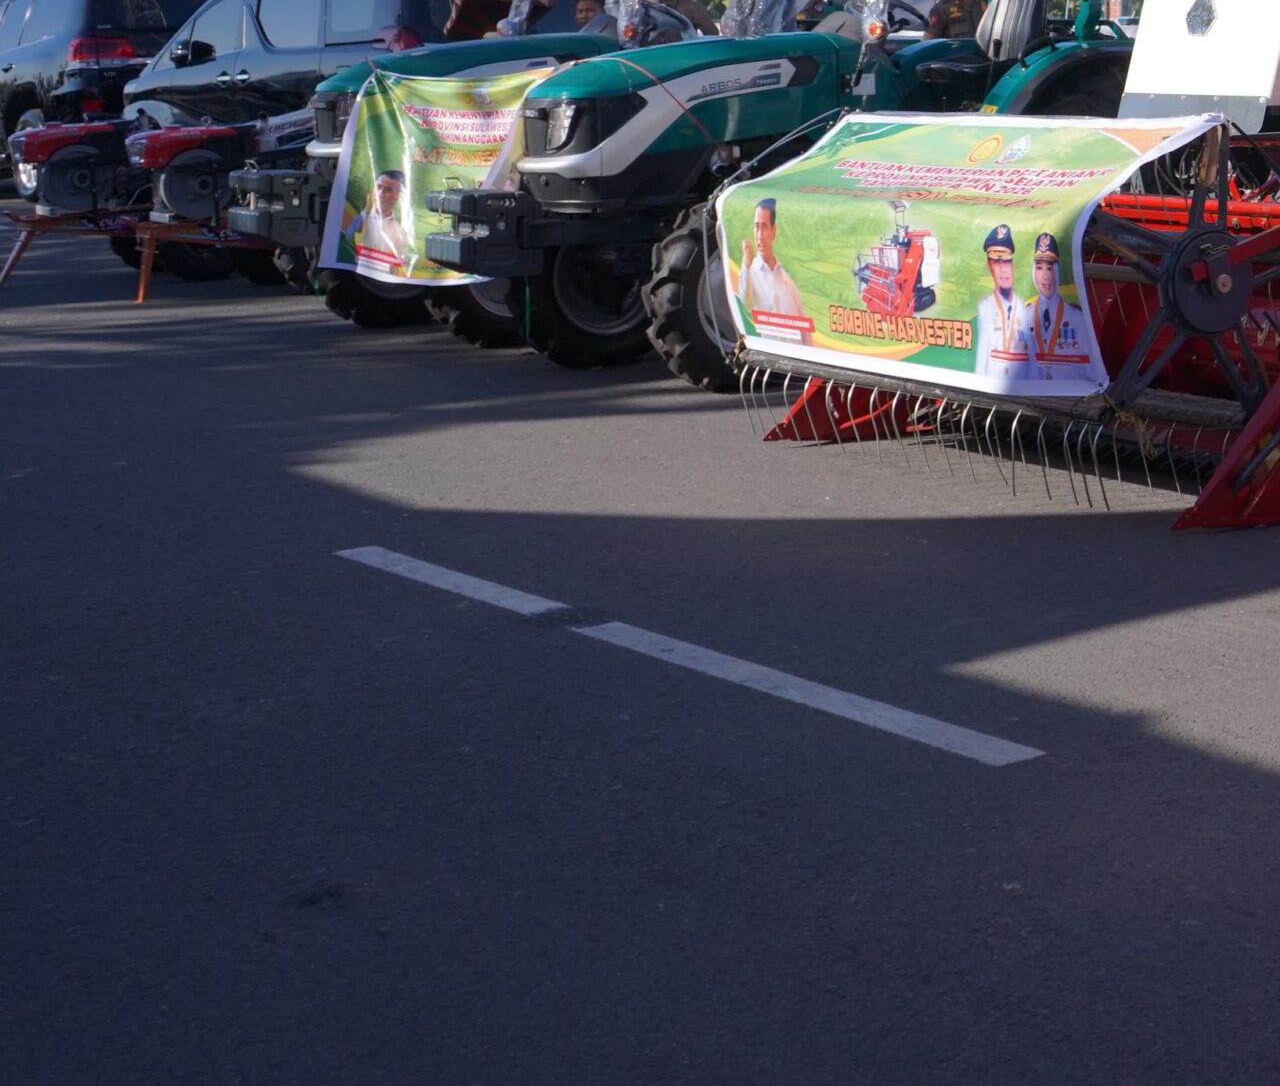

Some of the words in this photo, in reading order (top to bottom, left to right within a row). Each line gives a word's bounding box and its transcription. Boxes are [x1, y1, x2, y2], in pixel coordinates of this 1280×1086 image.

[701, 78, 743, 95] ARBOS
[828, 305, 884, 336] COMBINE
[883, 314, 973, 350] HARVESTER
